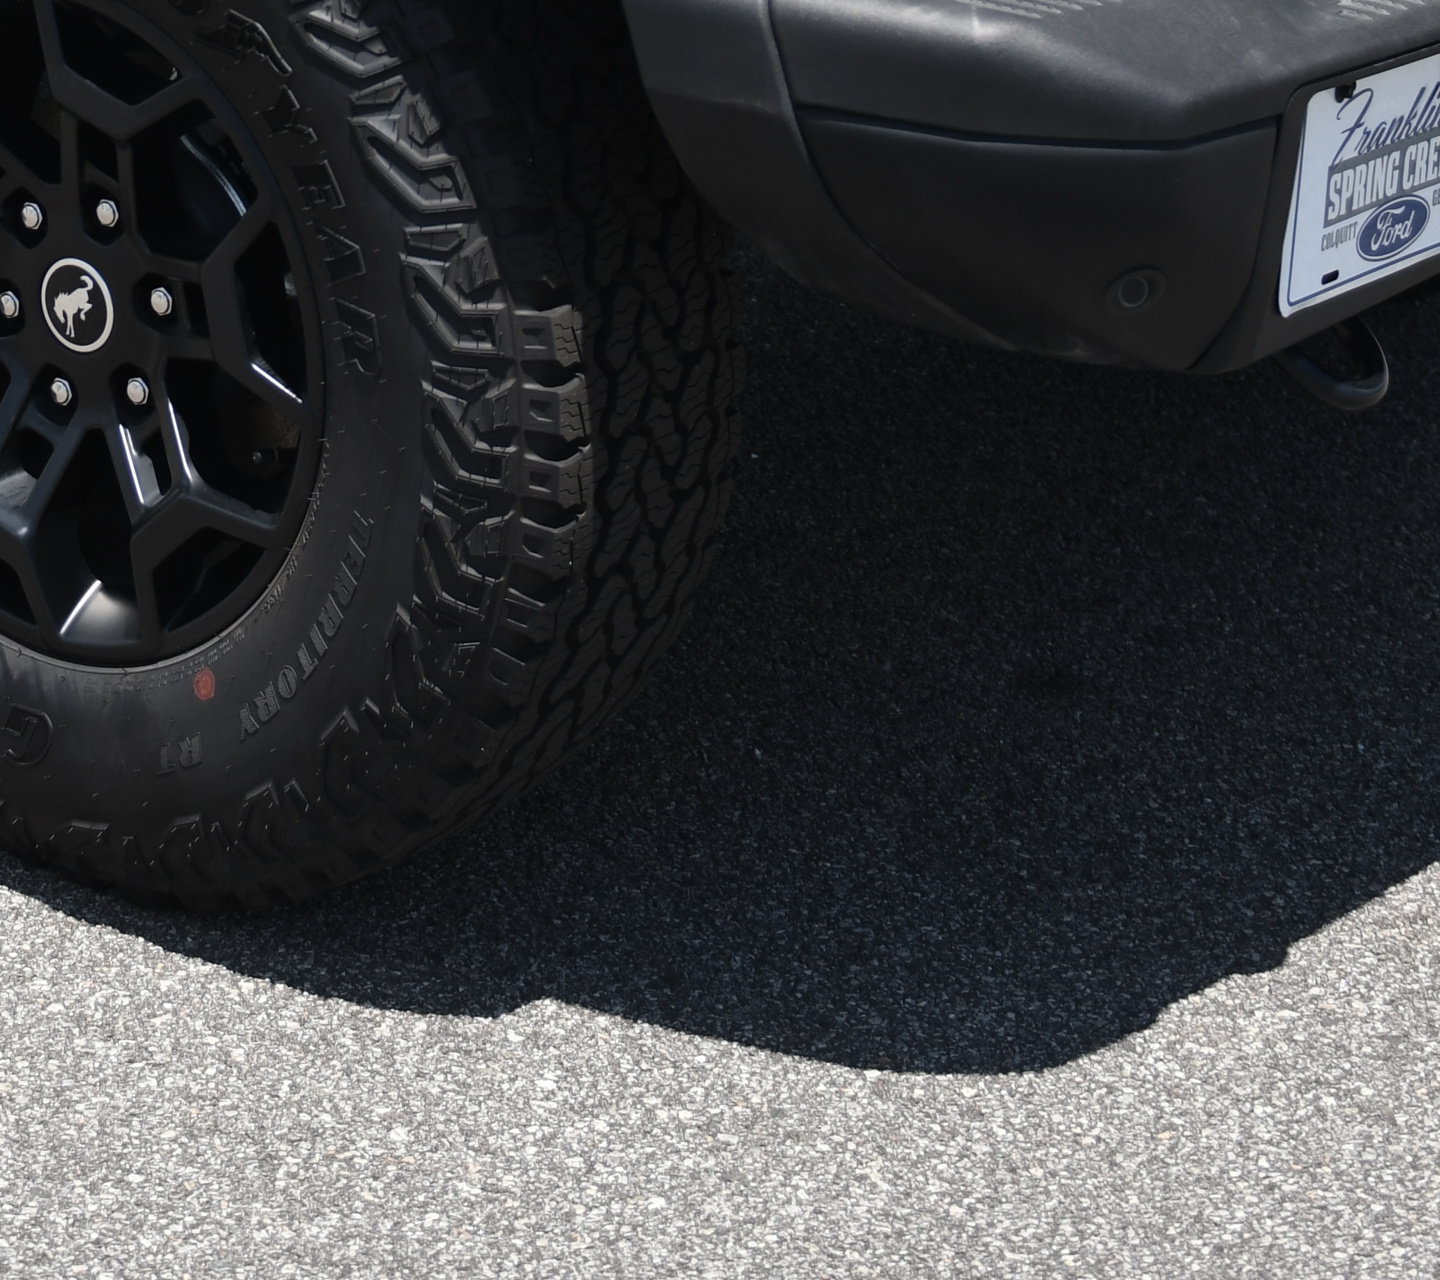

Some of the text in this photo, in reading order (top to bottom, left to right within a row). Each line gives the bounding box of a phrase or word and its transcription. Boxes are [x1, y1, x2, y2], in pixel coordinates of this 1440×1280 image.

[1328, 151, 1402, 221] SPRING
[1321, 221, 1358, 252] COLQUITT
[1370, 205, 1416, 252] Ford
[239, 509, 374, 744] TERRITORY
[155, 731, 203, 777] RT
